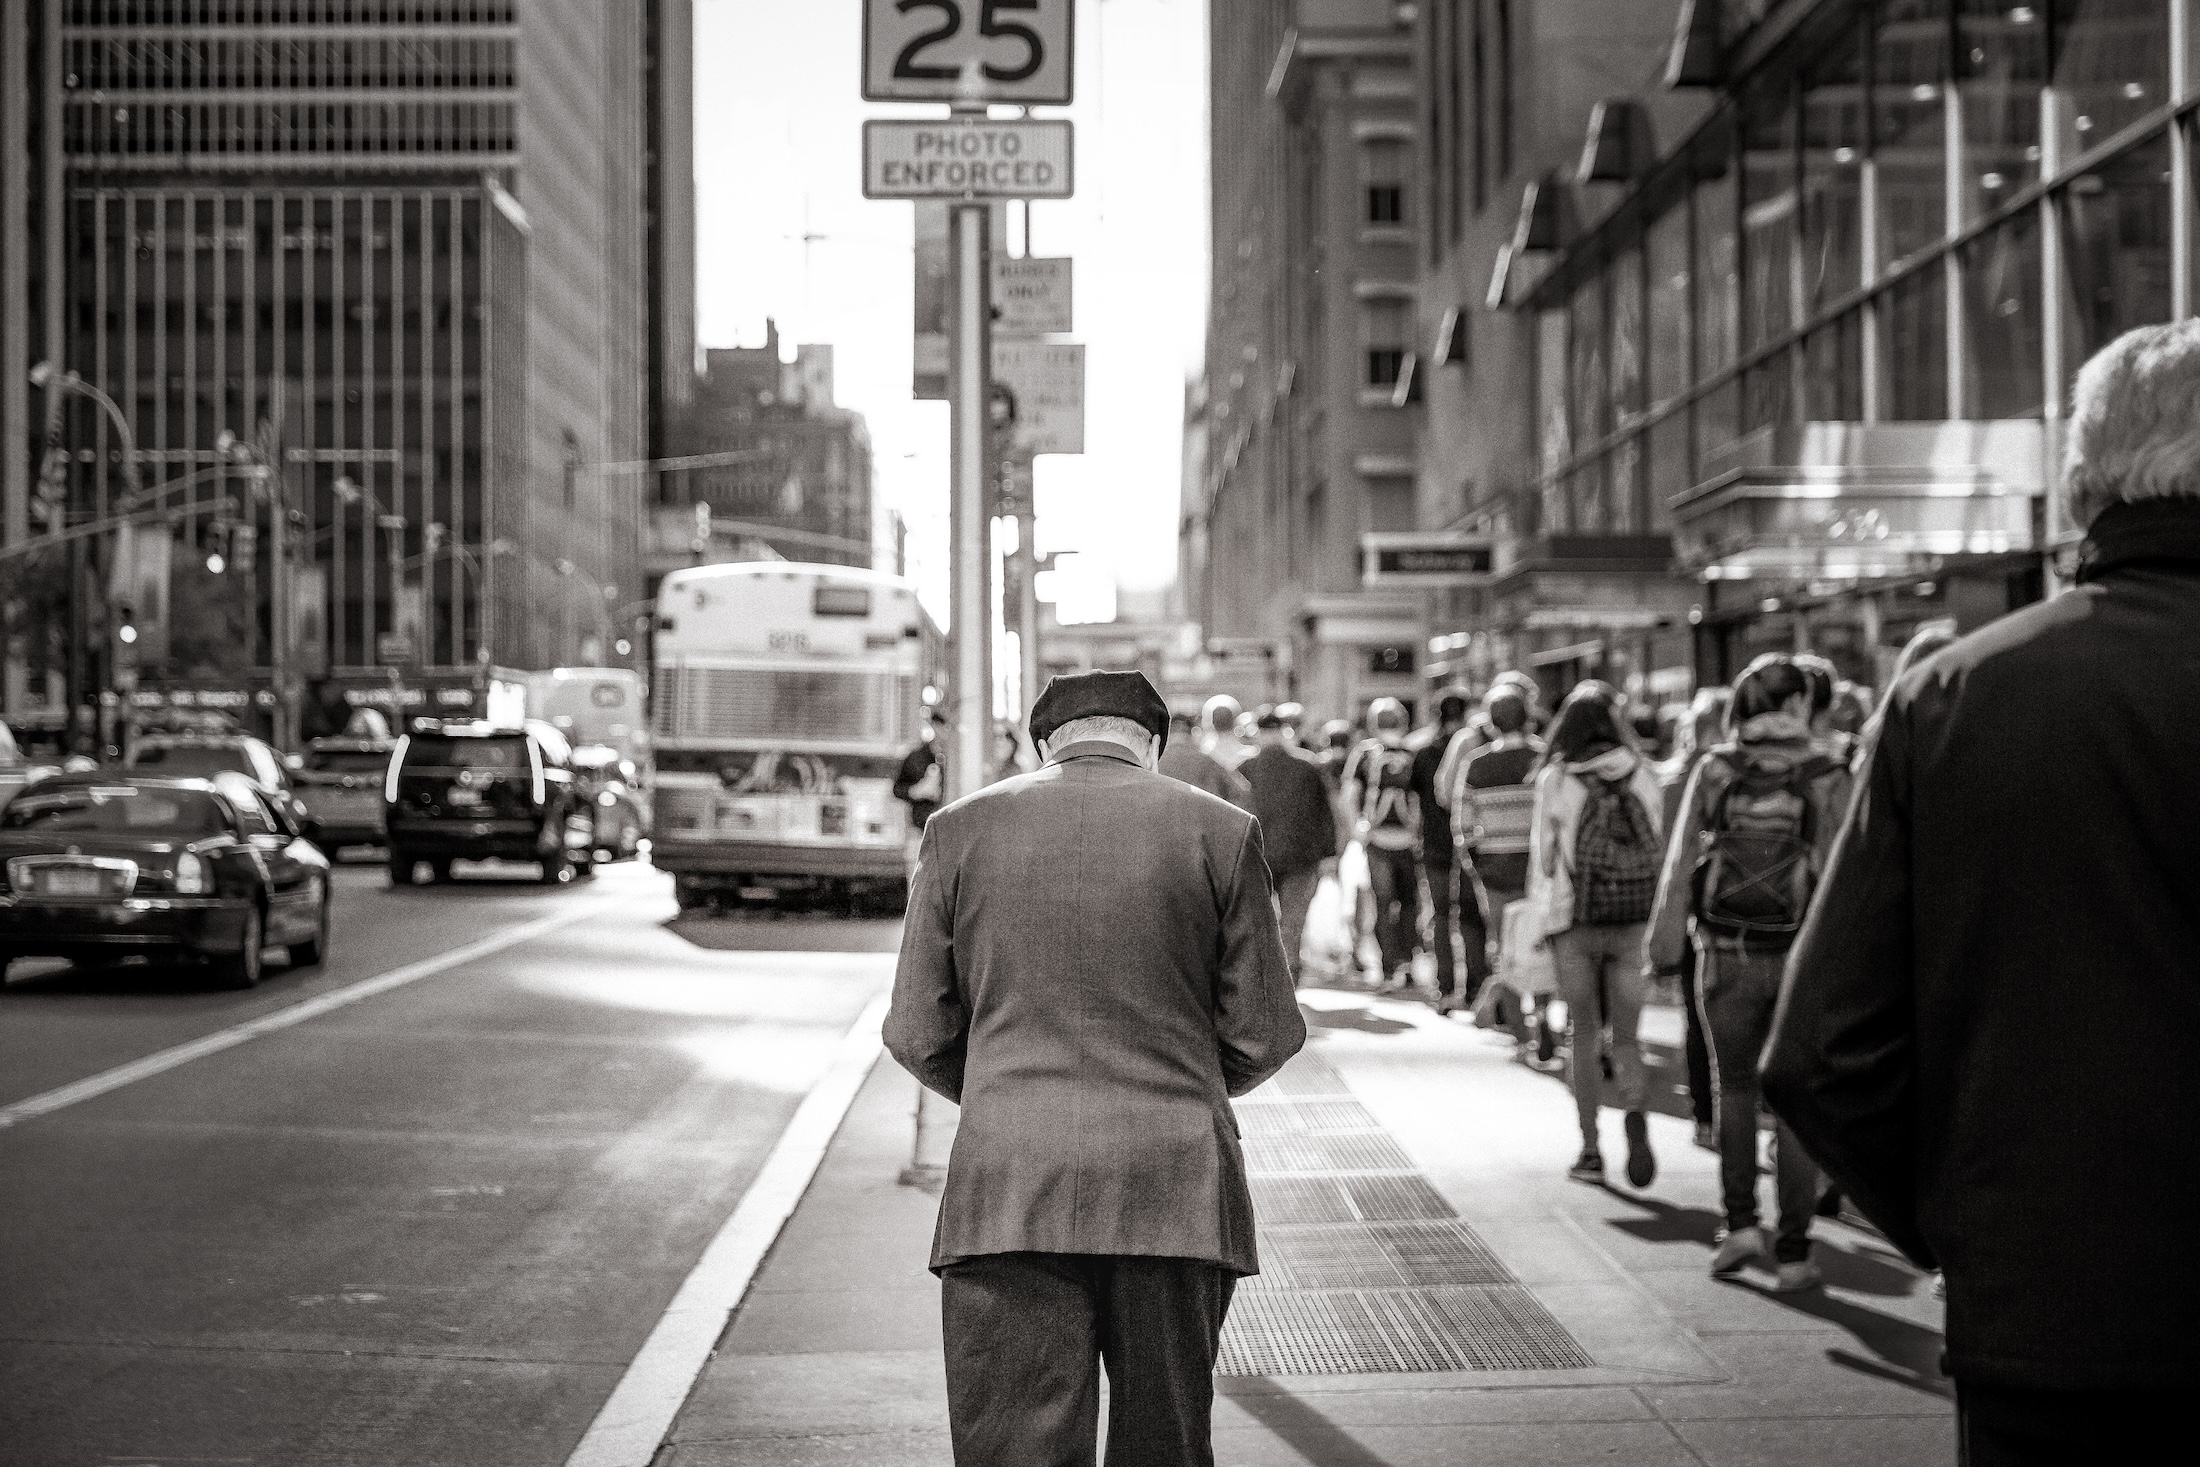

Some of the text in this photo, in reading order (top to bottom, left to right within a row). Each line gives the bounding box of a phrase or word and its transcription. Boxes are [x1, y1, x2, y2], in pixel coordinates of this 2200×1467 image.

[893, 0, 1043, 81] 25
[914, 132, 1021, 157] PHOTO
[882, 160, 1053, 186] ENFORCED
